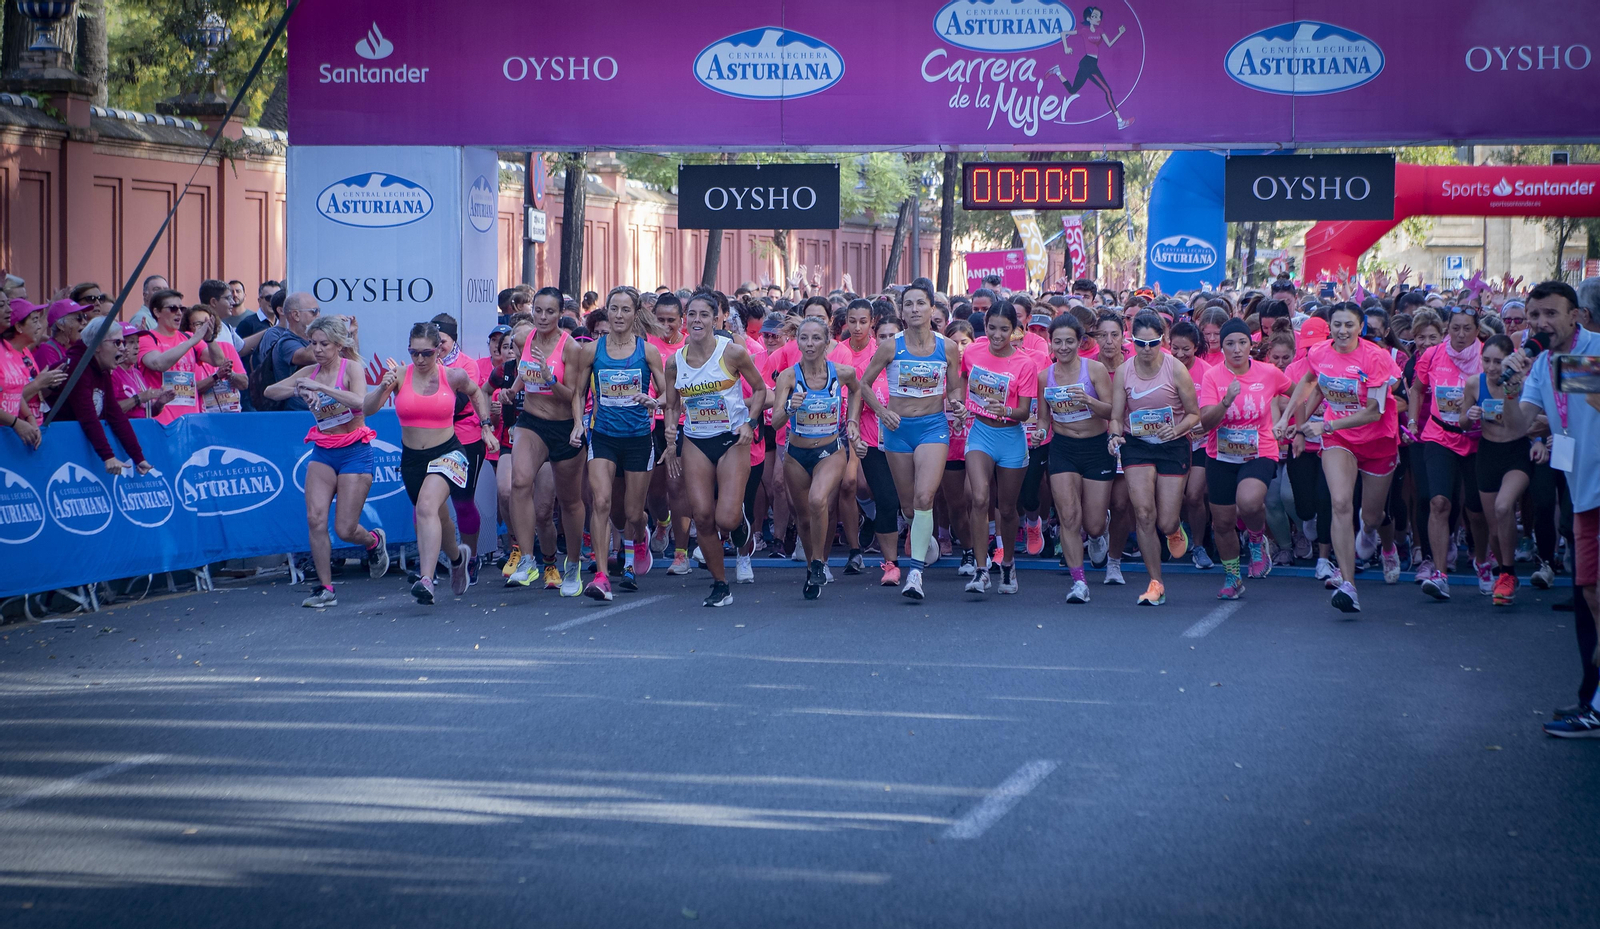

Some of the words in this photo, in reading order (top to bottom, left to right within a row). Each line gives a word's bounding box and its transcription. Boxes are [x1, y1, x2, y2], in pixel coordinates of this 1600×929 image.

[966, 8, 1010, 16] CENTRAL
[1014, 8, 1060, 16] LECHERA
[944, 10, 1064, 36] ASTURIANA
[1316, 45, 1367, 53] LECHERA
[1465, 44, 1592, 72] OYSHO
[502, 56, 618, 81] OYSHO
[705, 53, 833, 81] ASTURIANA
[920, 48, 1037, 83] Carrera
[1236, 48, 1372, 76] ASTURIANA
[319, 63, 429, 83] Santander
[948, 84, 971, 109] de
[974, 83, 990, 109] la
[986, 78, 1080, 137] Mujer
[1252, 175, 1371, 200] OYSHO
[1442, 180, 1490, 200] Sports
[1514, 179, 1596, 196] Santander
[325, 192, 425, 214] ASTURIANA
[704, 186, 817, 211] OYSHO
[1154, 247, 1212, 264] ASTURIANA
[1450, 257, 1460, 269] P
[967, 267, 1004, 279] ANDAR
[313, 277, 434, 303] OYSHO
[467, 277, 494, 303] OYSHO
[174, 384, 189, 392] 016
[680, 380, 722, 394] eMotion
[978, 384, 994, 394] 016
[1329, 390, 1345, 398] 016
[321, 403, 336, 413] 016
[699, 408, 717, 416] 016
[1057, 400, 1074, 408] 016
[226, 465, 268, 476] LECHERA
[119, 484, 172, 511] ASTURIANA
[183, 475, 276, 505] ATURIANA
[53, 491, 110, 519] ASTURIANA
